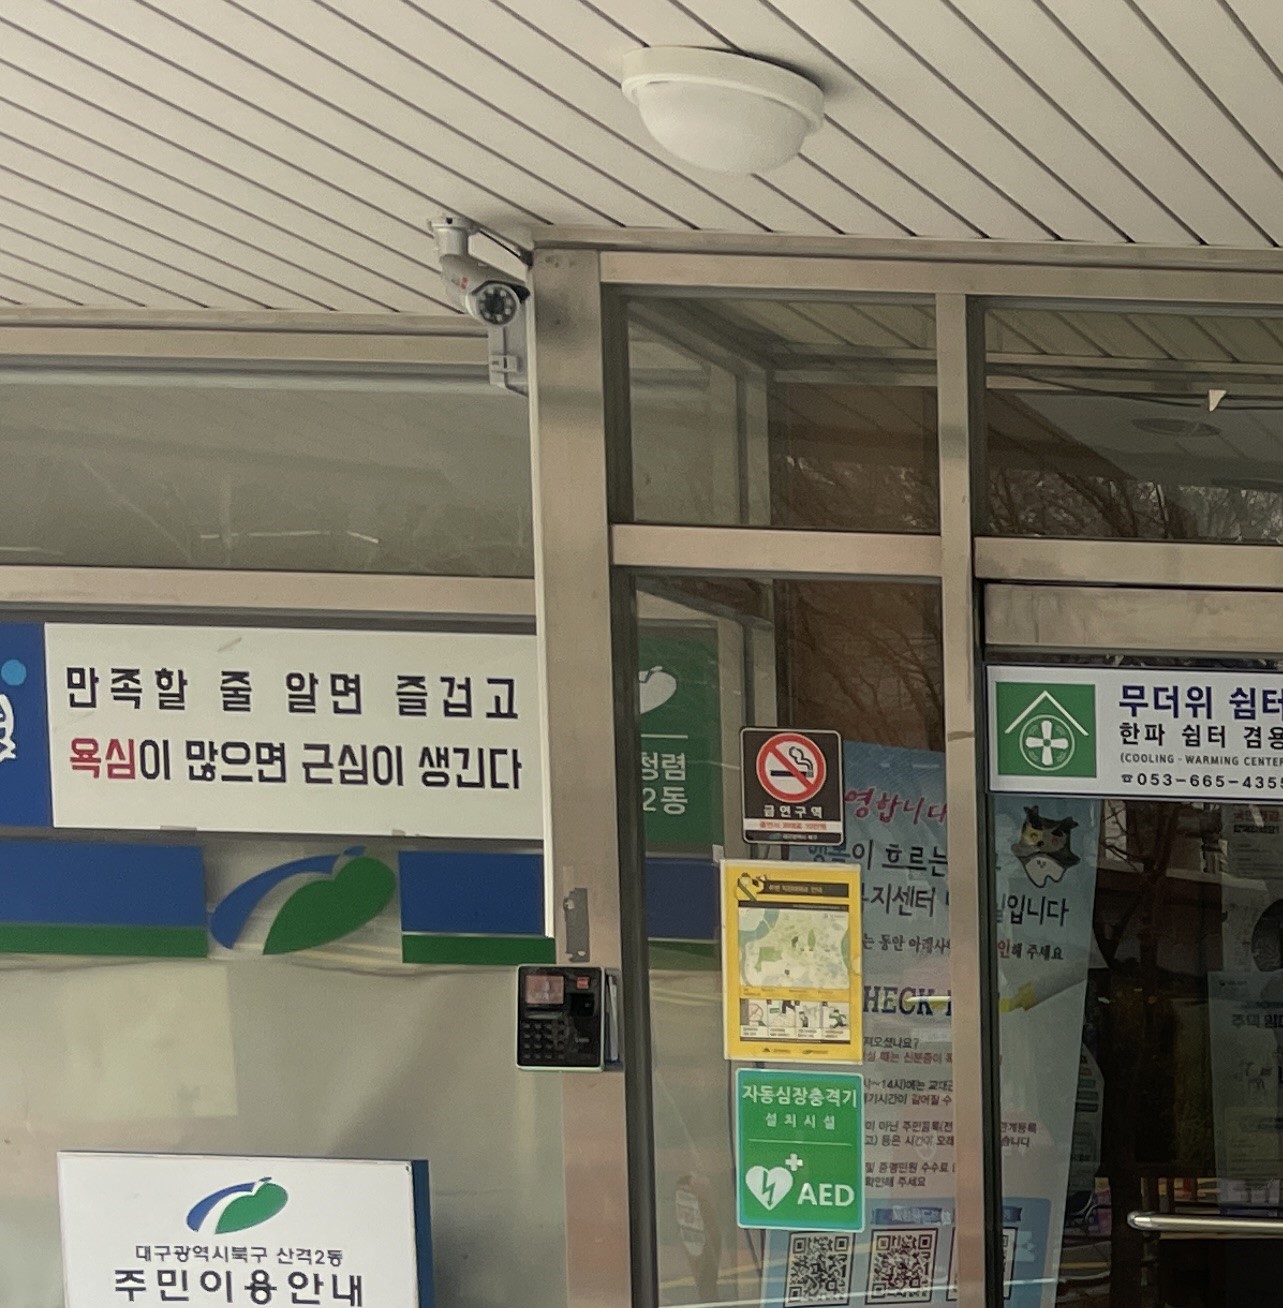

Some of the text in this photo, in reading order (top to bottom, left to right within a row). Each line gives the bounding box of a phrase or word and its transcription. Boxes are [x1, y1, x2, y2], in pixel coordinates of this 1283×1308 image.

[66, 666, 519, 721] 만족할 줄 알면 즐겁고
[1119, 685, 1212, 719] 무더위
[1119, 722, 1165, 746] 한파
[1182, 724, 1226, 748] 쉼터
[69, 738, 522, 790] 욕심이 많으면 근심이 생긴다
[1120, 752, 1174, 764] (COOLING
[1185, 755, 1239, 765] WARMING
[764, 805, 822, 818] 금연구역
[845, 786, 947, 824] 영합니다
[996, 894, 1069, 926] 입니다
[863, 985, 934, 1016] HECK
[742, 1084, 857, 1108] 자동심장충격기
[765, 1113, 835, 1130] 설치시설
[798, 1183, 855, 1207] AED
[135, 1244, 343, 1267] 대구광역시북구 산격2동
[114, 1268, 363, 1308] 주민이용안내
